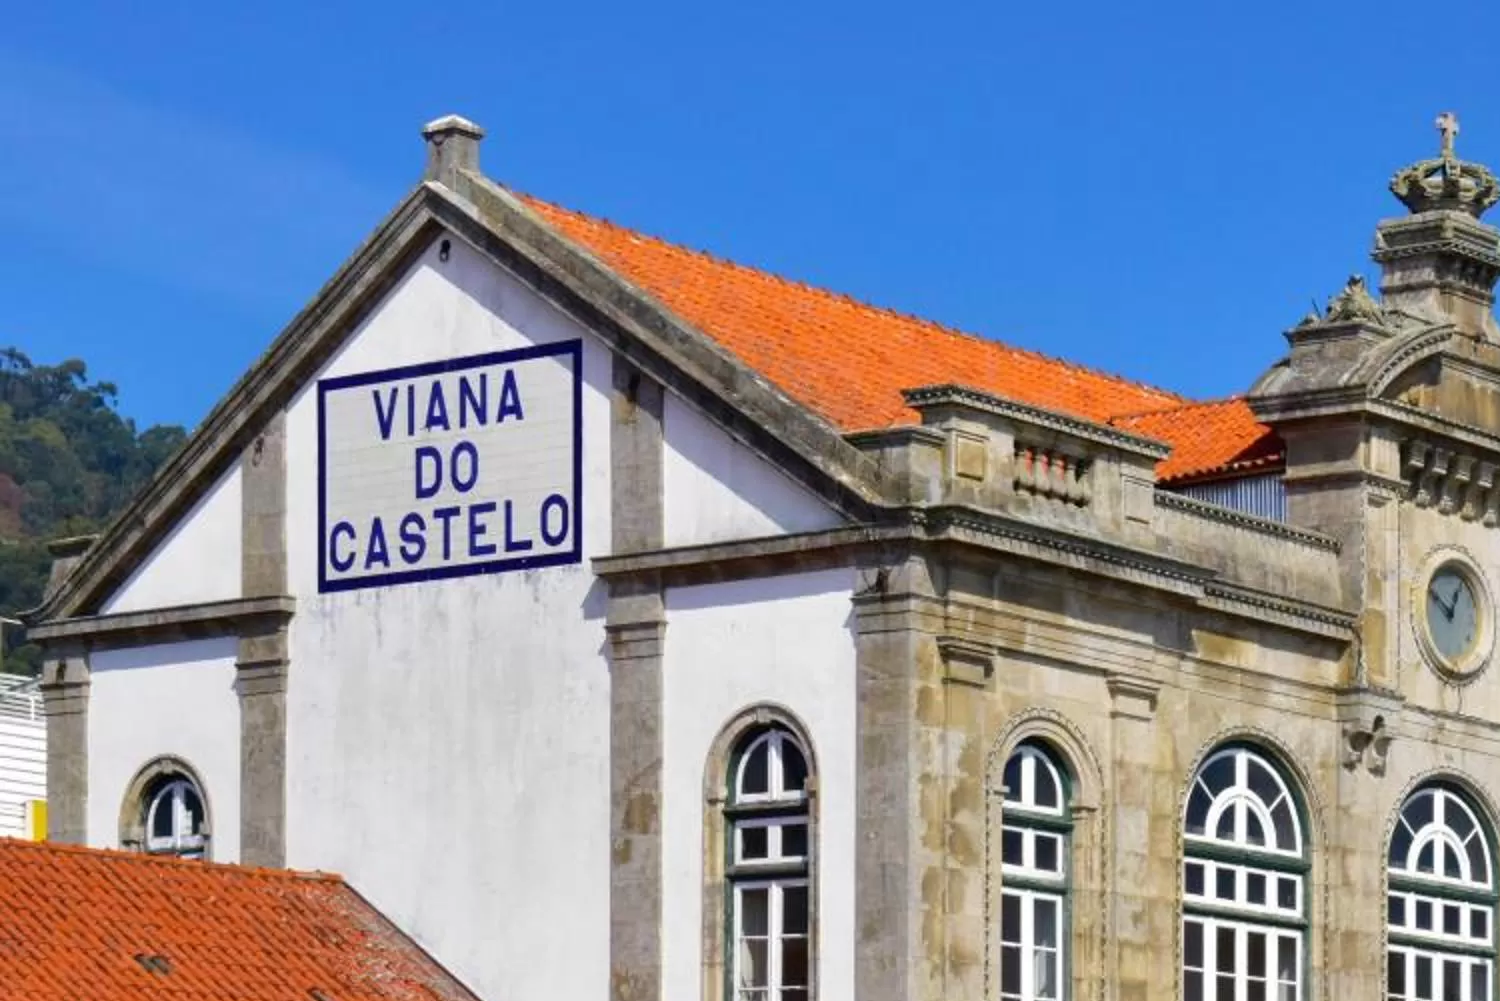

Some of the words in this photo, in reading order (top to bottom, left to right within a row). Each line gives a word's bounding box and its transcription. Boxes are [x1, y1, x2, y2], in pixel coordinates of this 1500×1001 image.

[372, 369, 524, 440] VIANA
[415, 440, 479, 499] DO
[329, 493, 569, 572] CASTELO
